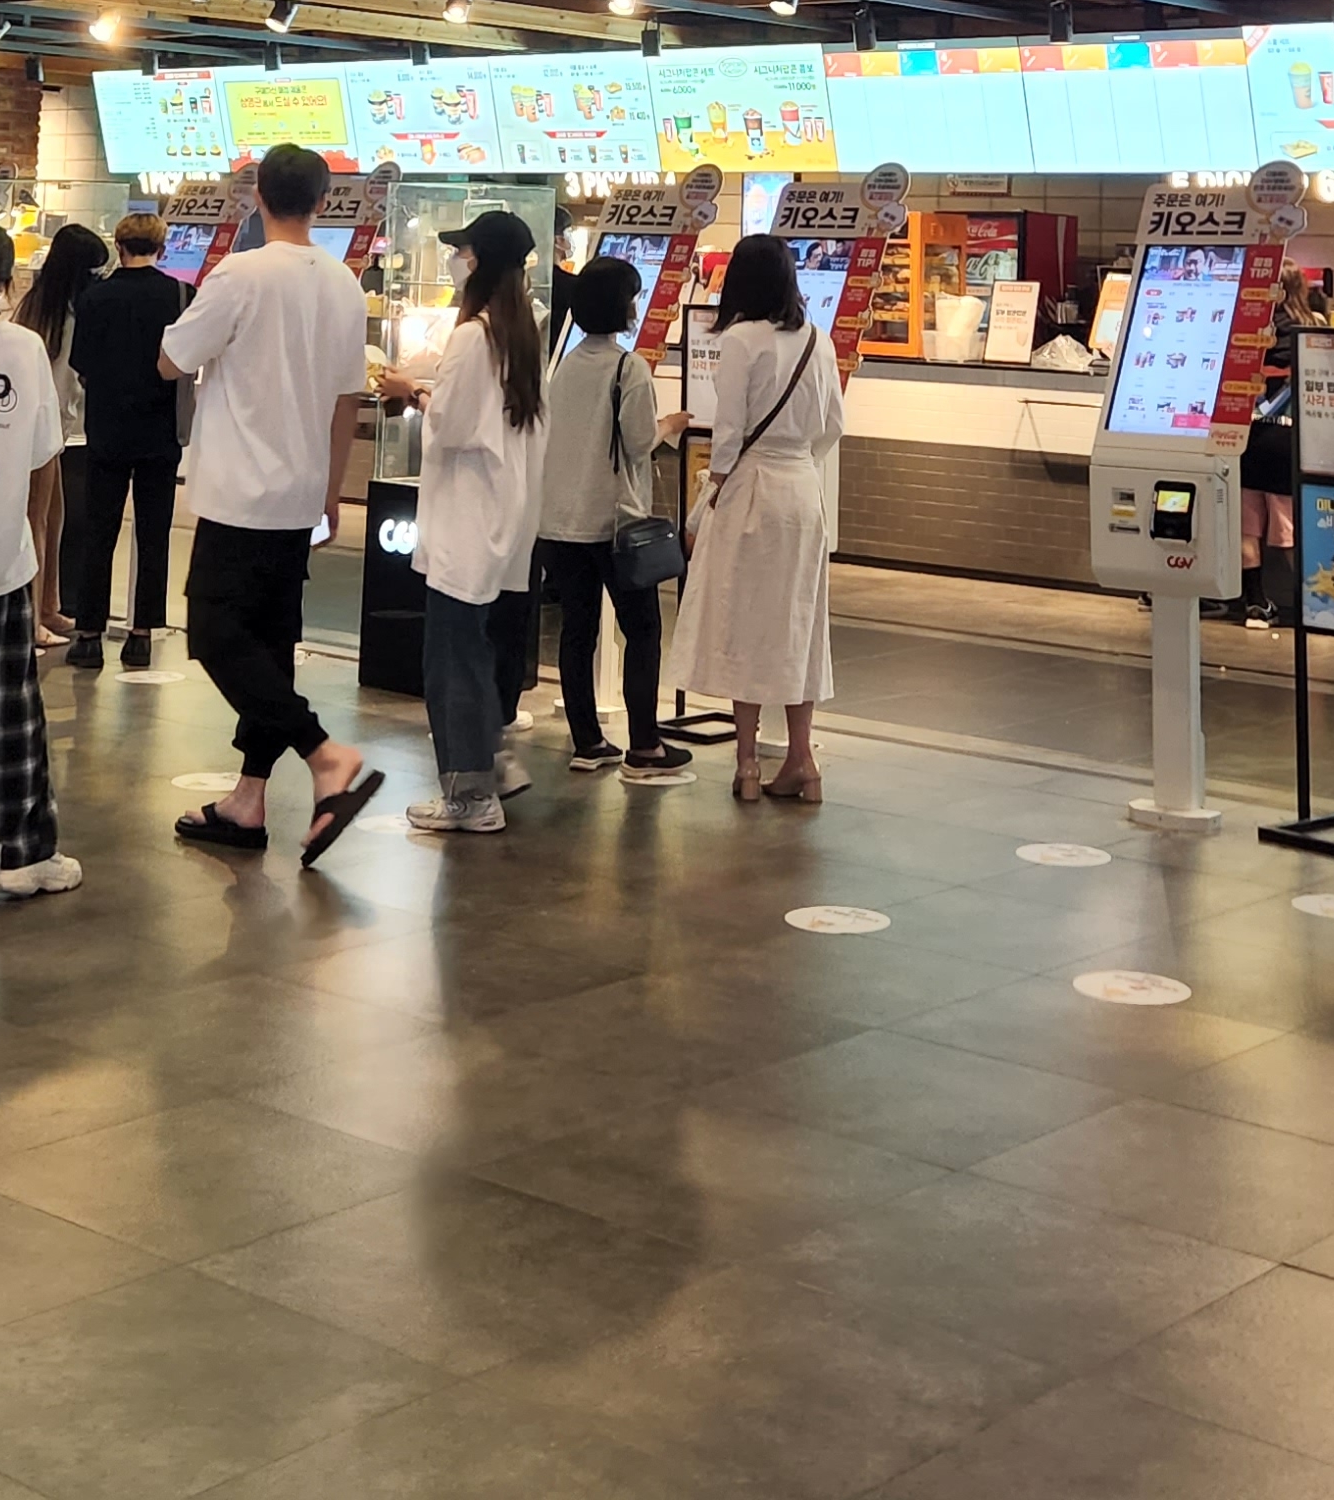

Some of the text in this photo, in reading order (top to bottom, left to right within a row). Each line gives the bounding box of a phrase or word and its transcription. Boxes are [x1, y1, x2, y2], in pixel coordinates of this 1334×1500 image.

[564, 172, 581, 197] 3
[614, 189, 665, 202] 주문은 여기!
[786, 190, 844, 203] 주문은 여기!
[1152, 193, 1225, 208] 주문은 여기!
[169, 199, 223, 217] 키오스크
[604, 204, 677, 227] 키오스크
[779, 206, 859, 229] 키오스크
[1147, 211, 1247, 237] 키오스크
[1249, 266, 1273, 278] TIP!
[1304, 380, 1324, 393] 일부
[1167, 555, 1193, 569] CGV
